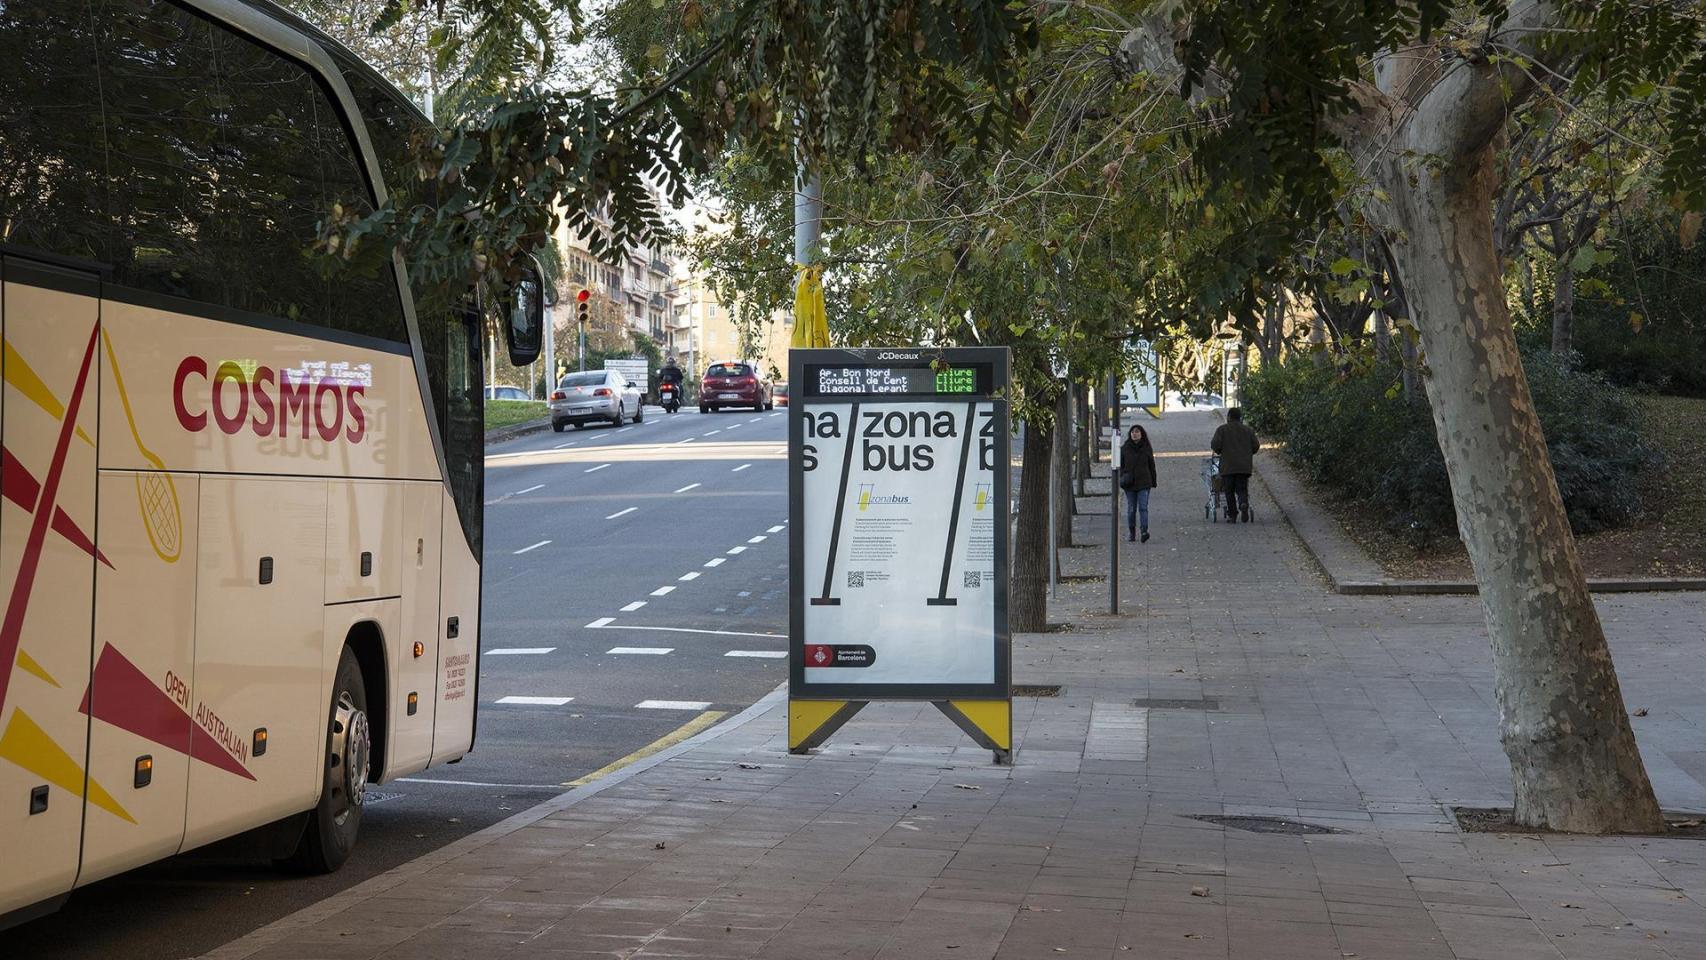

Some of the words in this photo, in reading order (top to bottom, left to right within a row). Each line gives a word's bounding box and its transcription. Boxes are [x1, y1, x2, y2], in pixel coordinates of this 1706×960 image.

[877, 352, 919, 360] JCDecaux
[843, 369, 861, 377] Bon
[866, 369, 890, 377] Nord
[819, 376, 861, 385] Consell
[866, 377, 879, 385] de
[883, 377, 908, 385] Cent
[937, 377, 973, 385] Lliure
[819, 384, 866, 392] Diagonal
[872, 384, 908, 392] Lepant
[937, 384, 973, 392] Lliure
[173, 355, 366, 444] COSMOS
[863, 410, 957, 438] zona
[863, 438, 935, 471] bus
[870, 494, 909, 503] zonabus
[165, 670, 190, 708] OPEN
[195, 701, 248, 764] AUSTRALIAN
